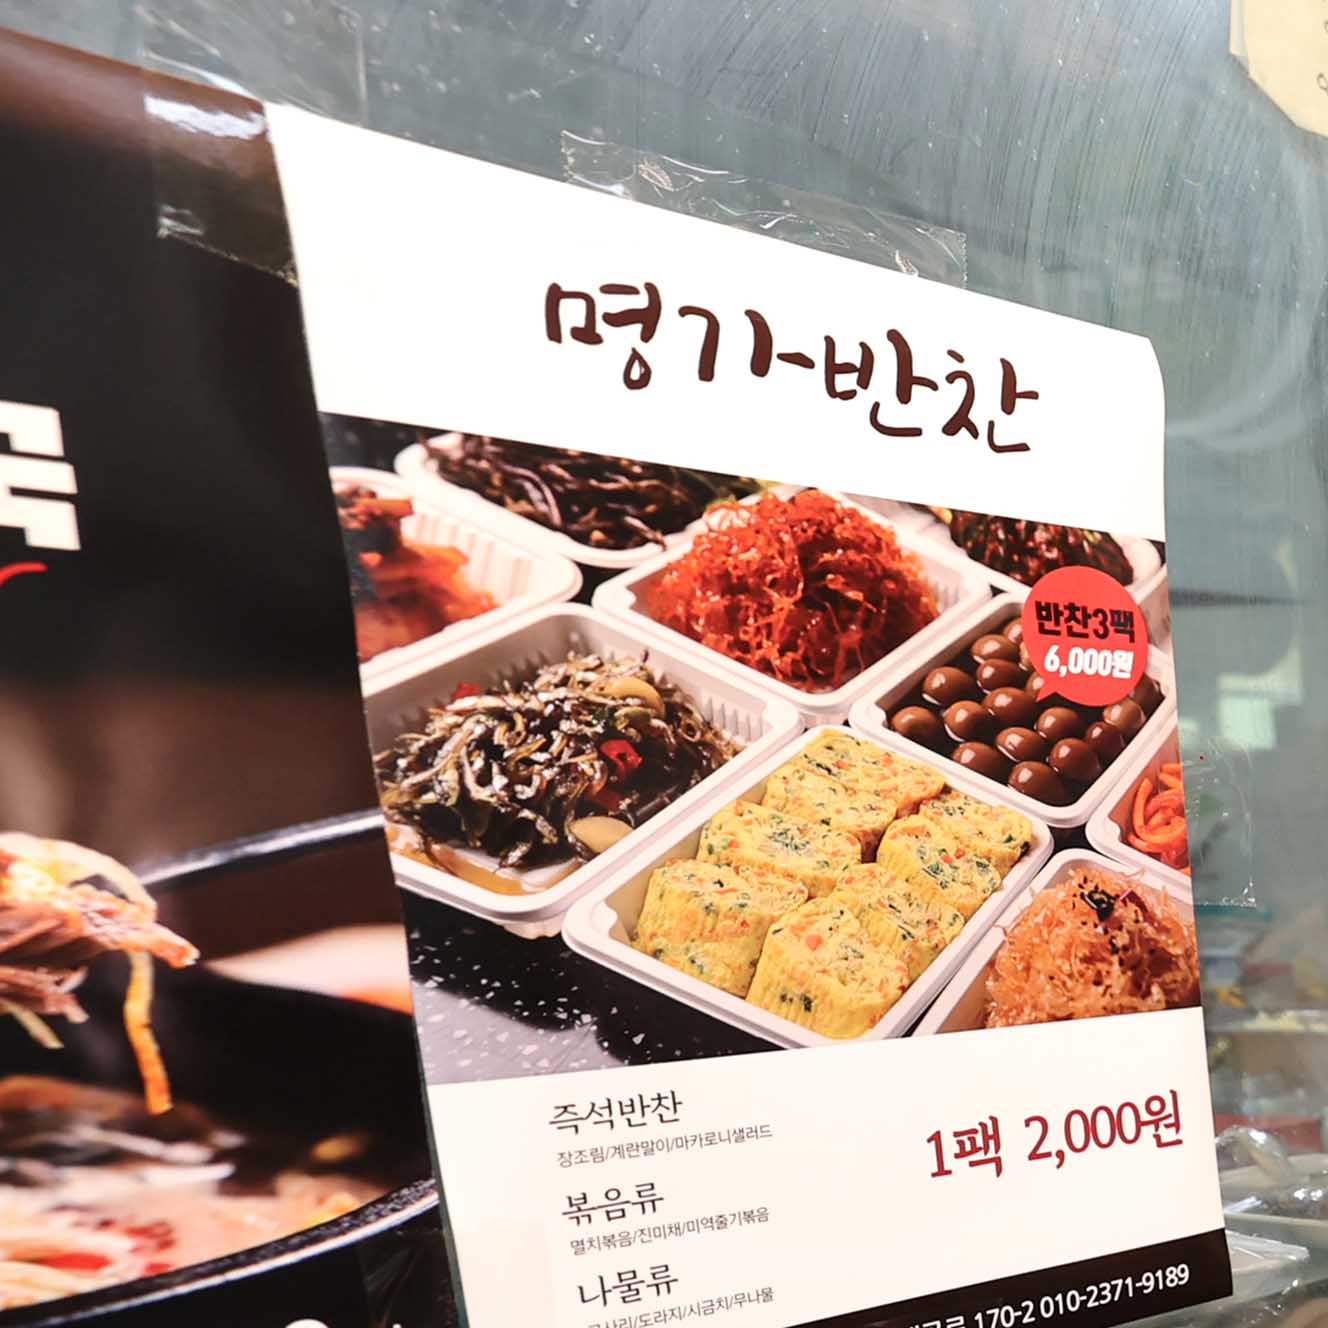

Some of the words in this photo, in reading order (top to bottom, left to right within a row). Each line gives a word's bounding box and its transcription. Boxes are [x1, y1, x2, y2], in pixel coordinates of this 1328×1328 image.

[544, 281, 1040, 454] 명가반찬
[1034, 599, 1136, 644] 반찬3팩
[1043, 644, 1135, 680] 6,000원
[548, 1089, 684, 1136] 즉석반찬
[926, 1114, 1003, 1178] 1팩
[1024, 1089, 1183, 1170] 2,000원
[556, 1124, 774, 1168] 장조림/계란말이/마카로니샐러드
[561, 1182, 665, 1227] 볶음류
[570, 1207, 770, 1256] 멸치볶음/진미채/미역줄기볶음
[577, 1263, 679, 1309] 나물류
[1040, 1263, 1190, 1320] 010-2371-9189
